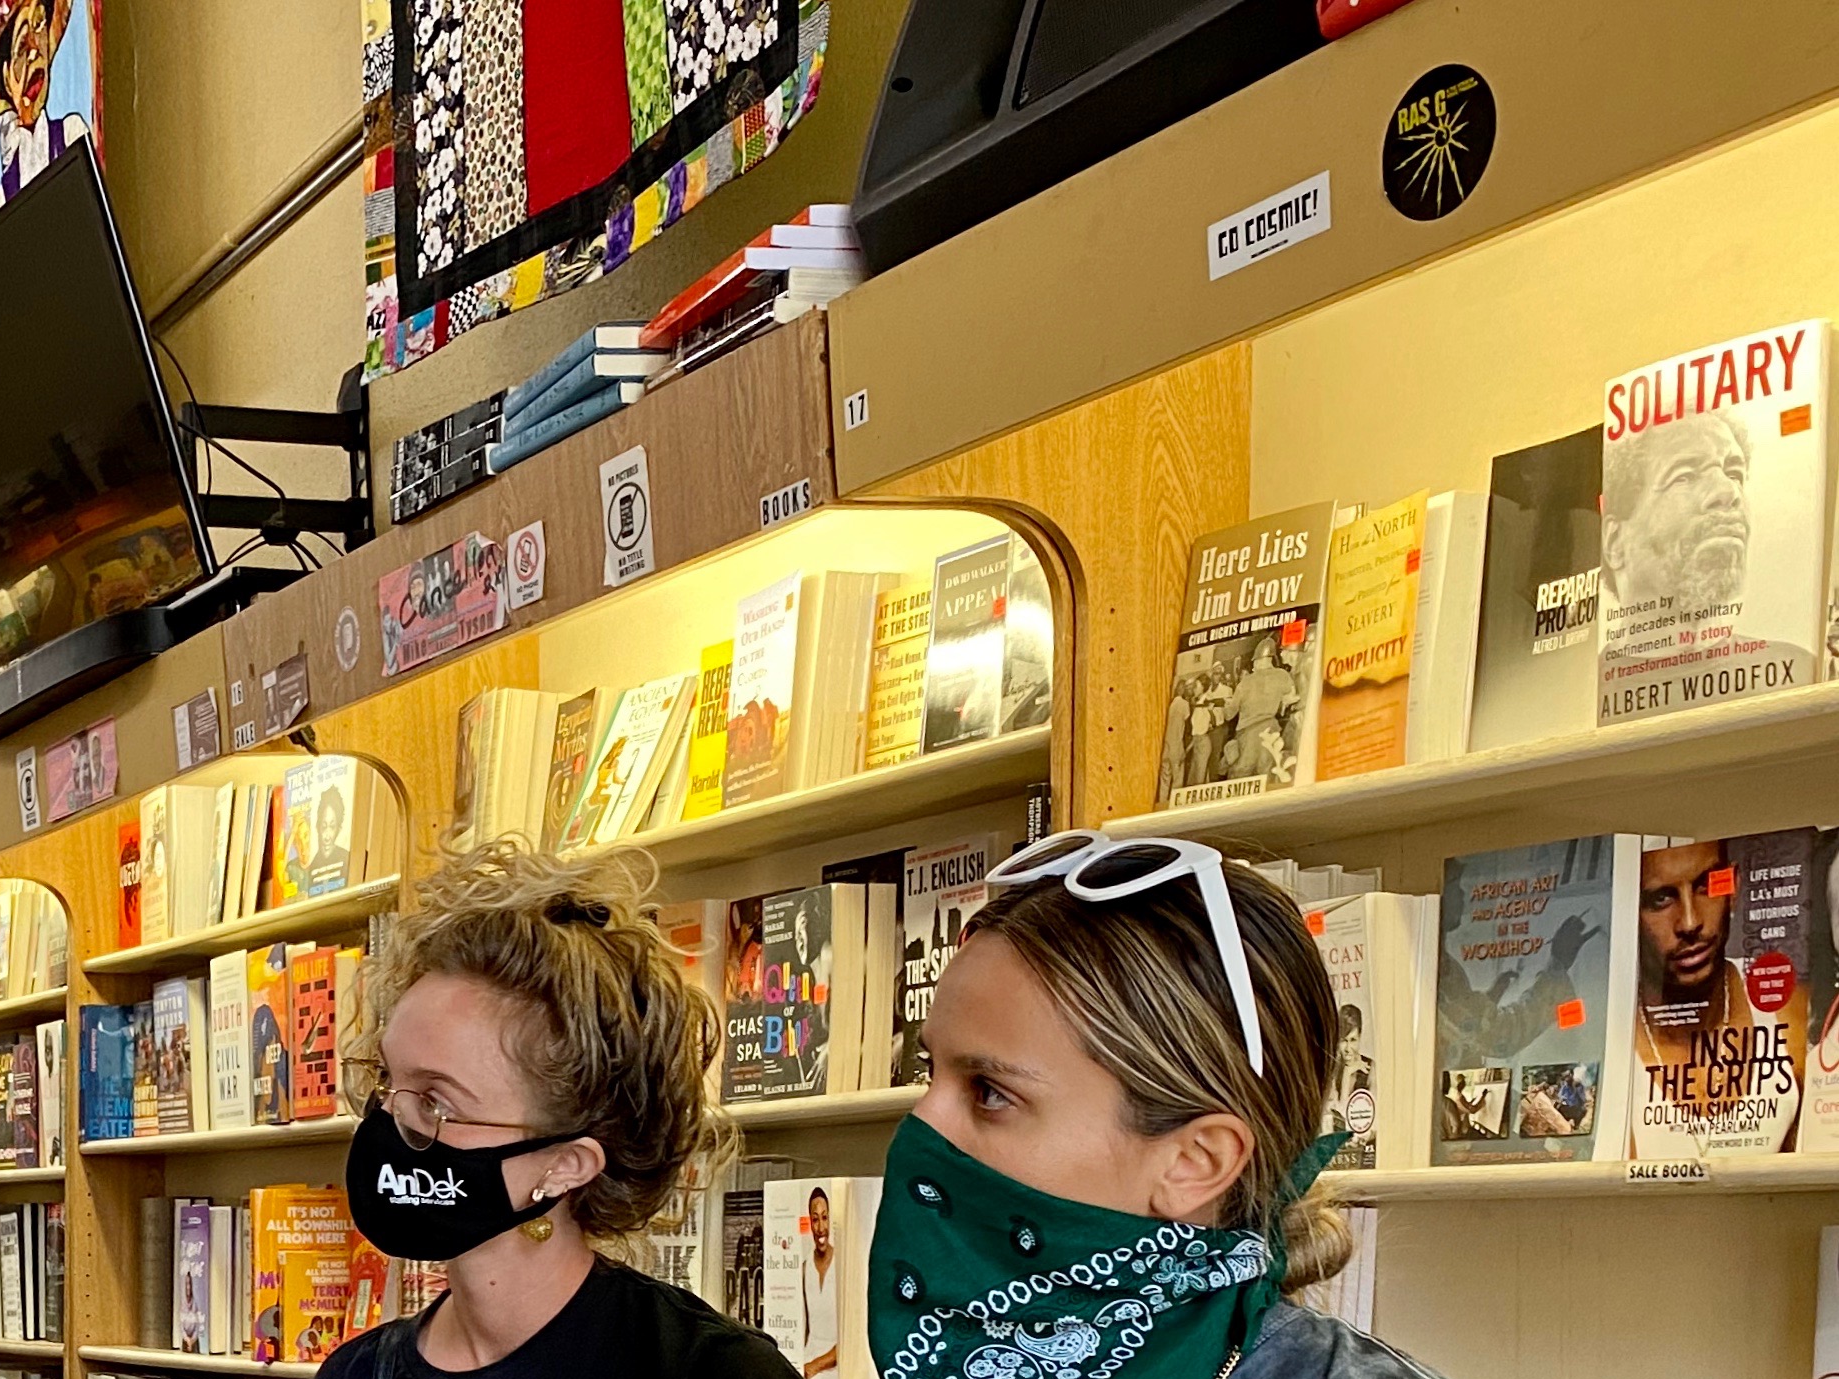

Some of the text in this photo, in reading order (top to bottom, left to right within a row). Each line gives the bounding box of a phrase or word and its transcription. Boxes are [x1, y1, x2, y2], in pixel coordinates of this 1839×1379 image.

[1398, 97, 1429, 135] RAS
[1218, 226, 1239, 259] GO
[1245, 188, 1319, 247] COSMIC!
[1607, 330, 1806, 442] SOLITARY
[848, 393, 865, 426] 17
[762, 481, 810, 526] BOOKS
[1372, 508, 1417, 542] NORTH
[1198, 529, 1308, 585] Here Lies
[878, 603, 889, 621] AT
[891, 597, 908, 617] THE
[1191, 573, 1304, 625] Jim Crow
[1606, 595, 1675, 622] Unbroken by
[877, 626, 889, 641] OF
[890, 619, 906, 637] THE
[1345, 601, 1394, 635] SLAVERY
[1606, 601, 1744, 642] four decades in solitary
[1188, 632, 1208, 648] CIVIL
[1209, 626, 1239, 645] RIGHTS
[1605, 624, 1734, 661] confinement. My story
[1326, 633, 1409, 680] COMPLICITY
[1604, 668, 1616, 682] of
[1617, 652, 1703, 679] transformation
[1706, 645, 1730, 660] and
[1600, 658, 1795, 719] ALBERT WOODFOX
[235, 722, 255, 749] SALE
[691, 769, 721, 795] Harold
[1183, 779, 1260, 804] FRASER SMITH
[905, 851, 986, 897] T.J. ENGLISH
[1470, 872, 1559, 902] AFRICAN ART
[1749, 864, 1802, 884] LIFE INSIDE
[1774, 885, 1800, 900] MOST
[1493, 897, 1550, 920] AGENCY
[1748, 904, 1800, 921] NOTORIOUS
[1760, 924, 1786, 940] GANG
[1462, 939, 1544, 962] WORKSHOP
[905, 959, 929, 985] THE
[212, 1002, 243, 1032] SOUTH
[1690, 1023, 1790, 1068] INSIDE
[216, 1046, 241, 1074] CIVIL
[219, 1076, 238, 1101] WAR
[1645, 1055, 1794, 1102] THE CRIPS
[1643, 1098, 1779, 1127] COLTON SIMPSON
[1686, 1120, 1761, 1136] ANN PEARLMAN
[377, 1163, 468, 1200] AnDek
[1629, 1164, 1706, 1180] SALE BOOKS
[266, 1219, 290, 1231] ALL
[287, 1206, 337, 1218] IT'S NOT
[278, 1232, 346, 1244] FROM HERE
[766, 1254, 799, 1269] the ball
[768, 1314, 798, 1333] tiffany
